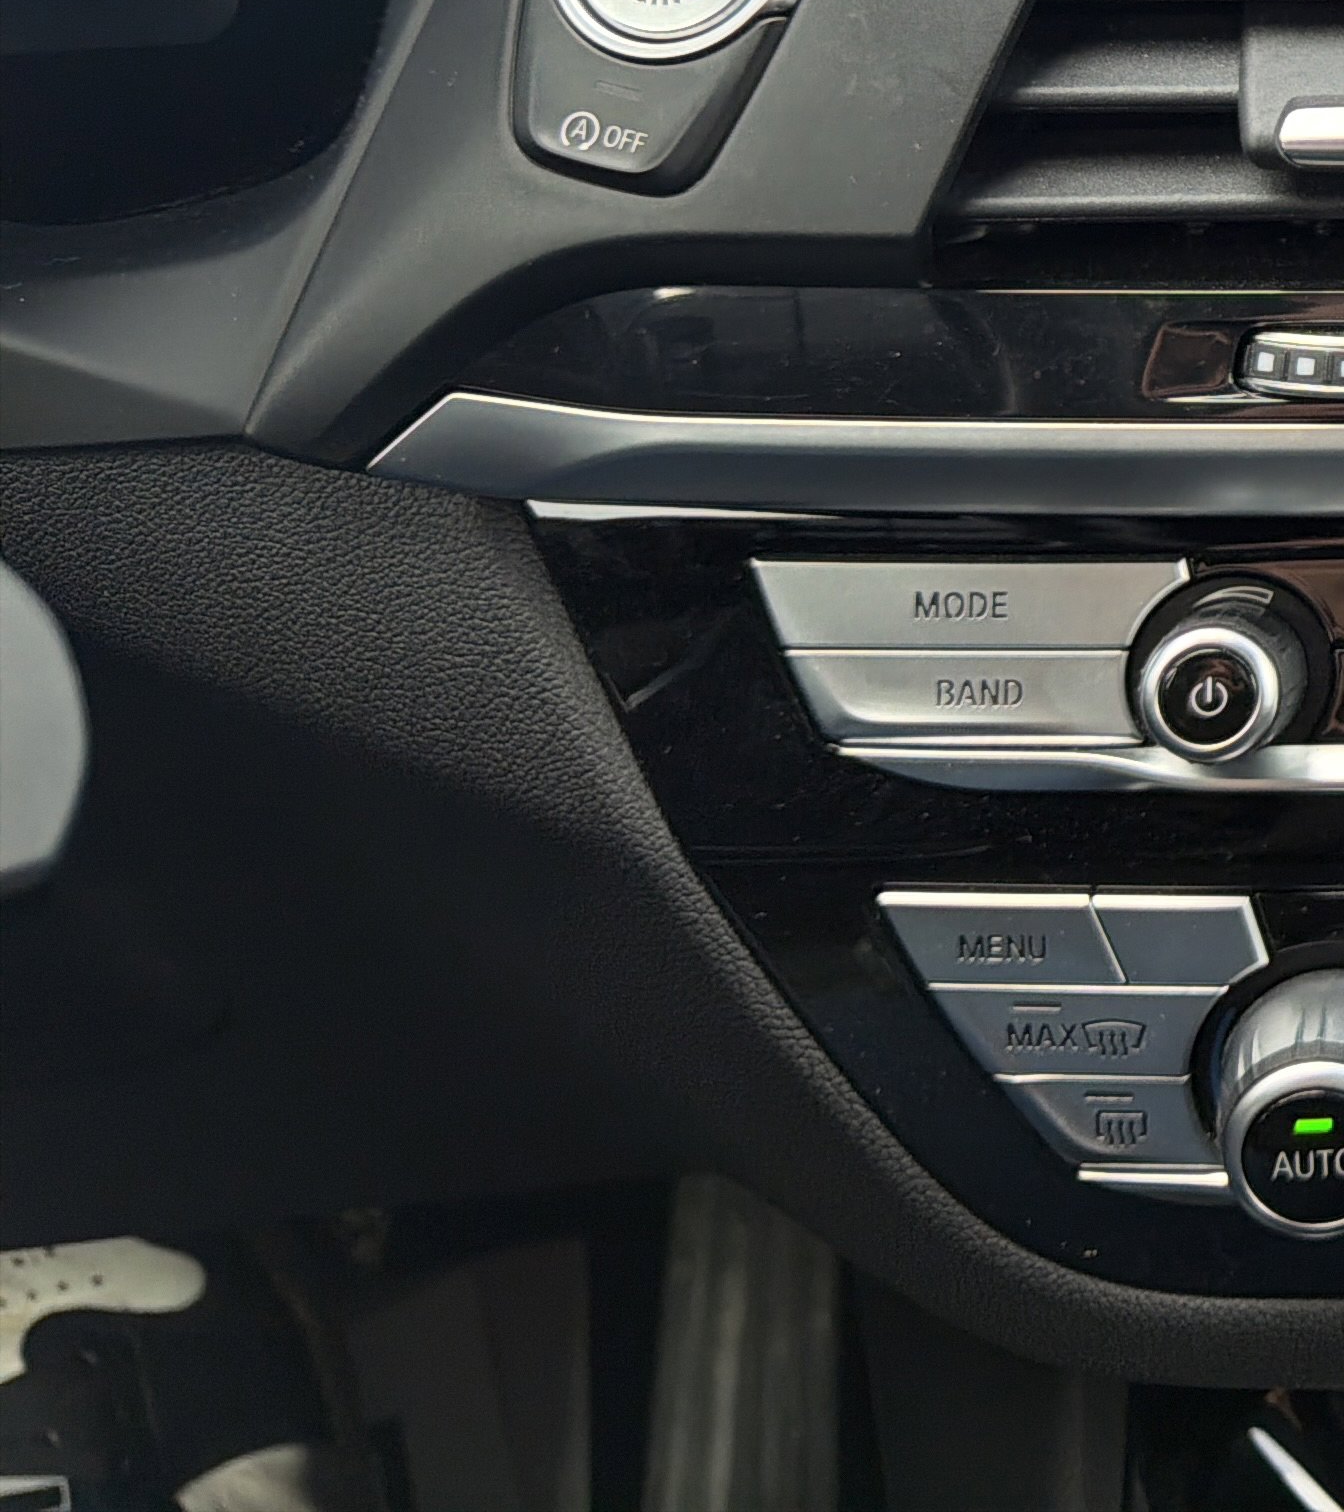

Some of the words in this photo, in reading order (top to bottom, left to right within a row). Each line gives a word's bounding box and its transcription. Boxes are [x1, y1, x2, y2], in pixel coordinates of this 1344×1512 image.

[602, 125, 649, 153] OFF
[913, 590, 1009, 622] MODE
[934, 678, 1025, 709] BAND
[956, 933, 1048, 964] MENU
[1004, 1021, 1080, 1054] MAX
